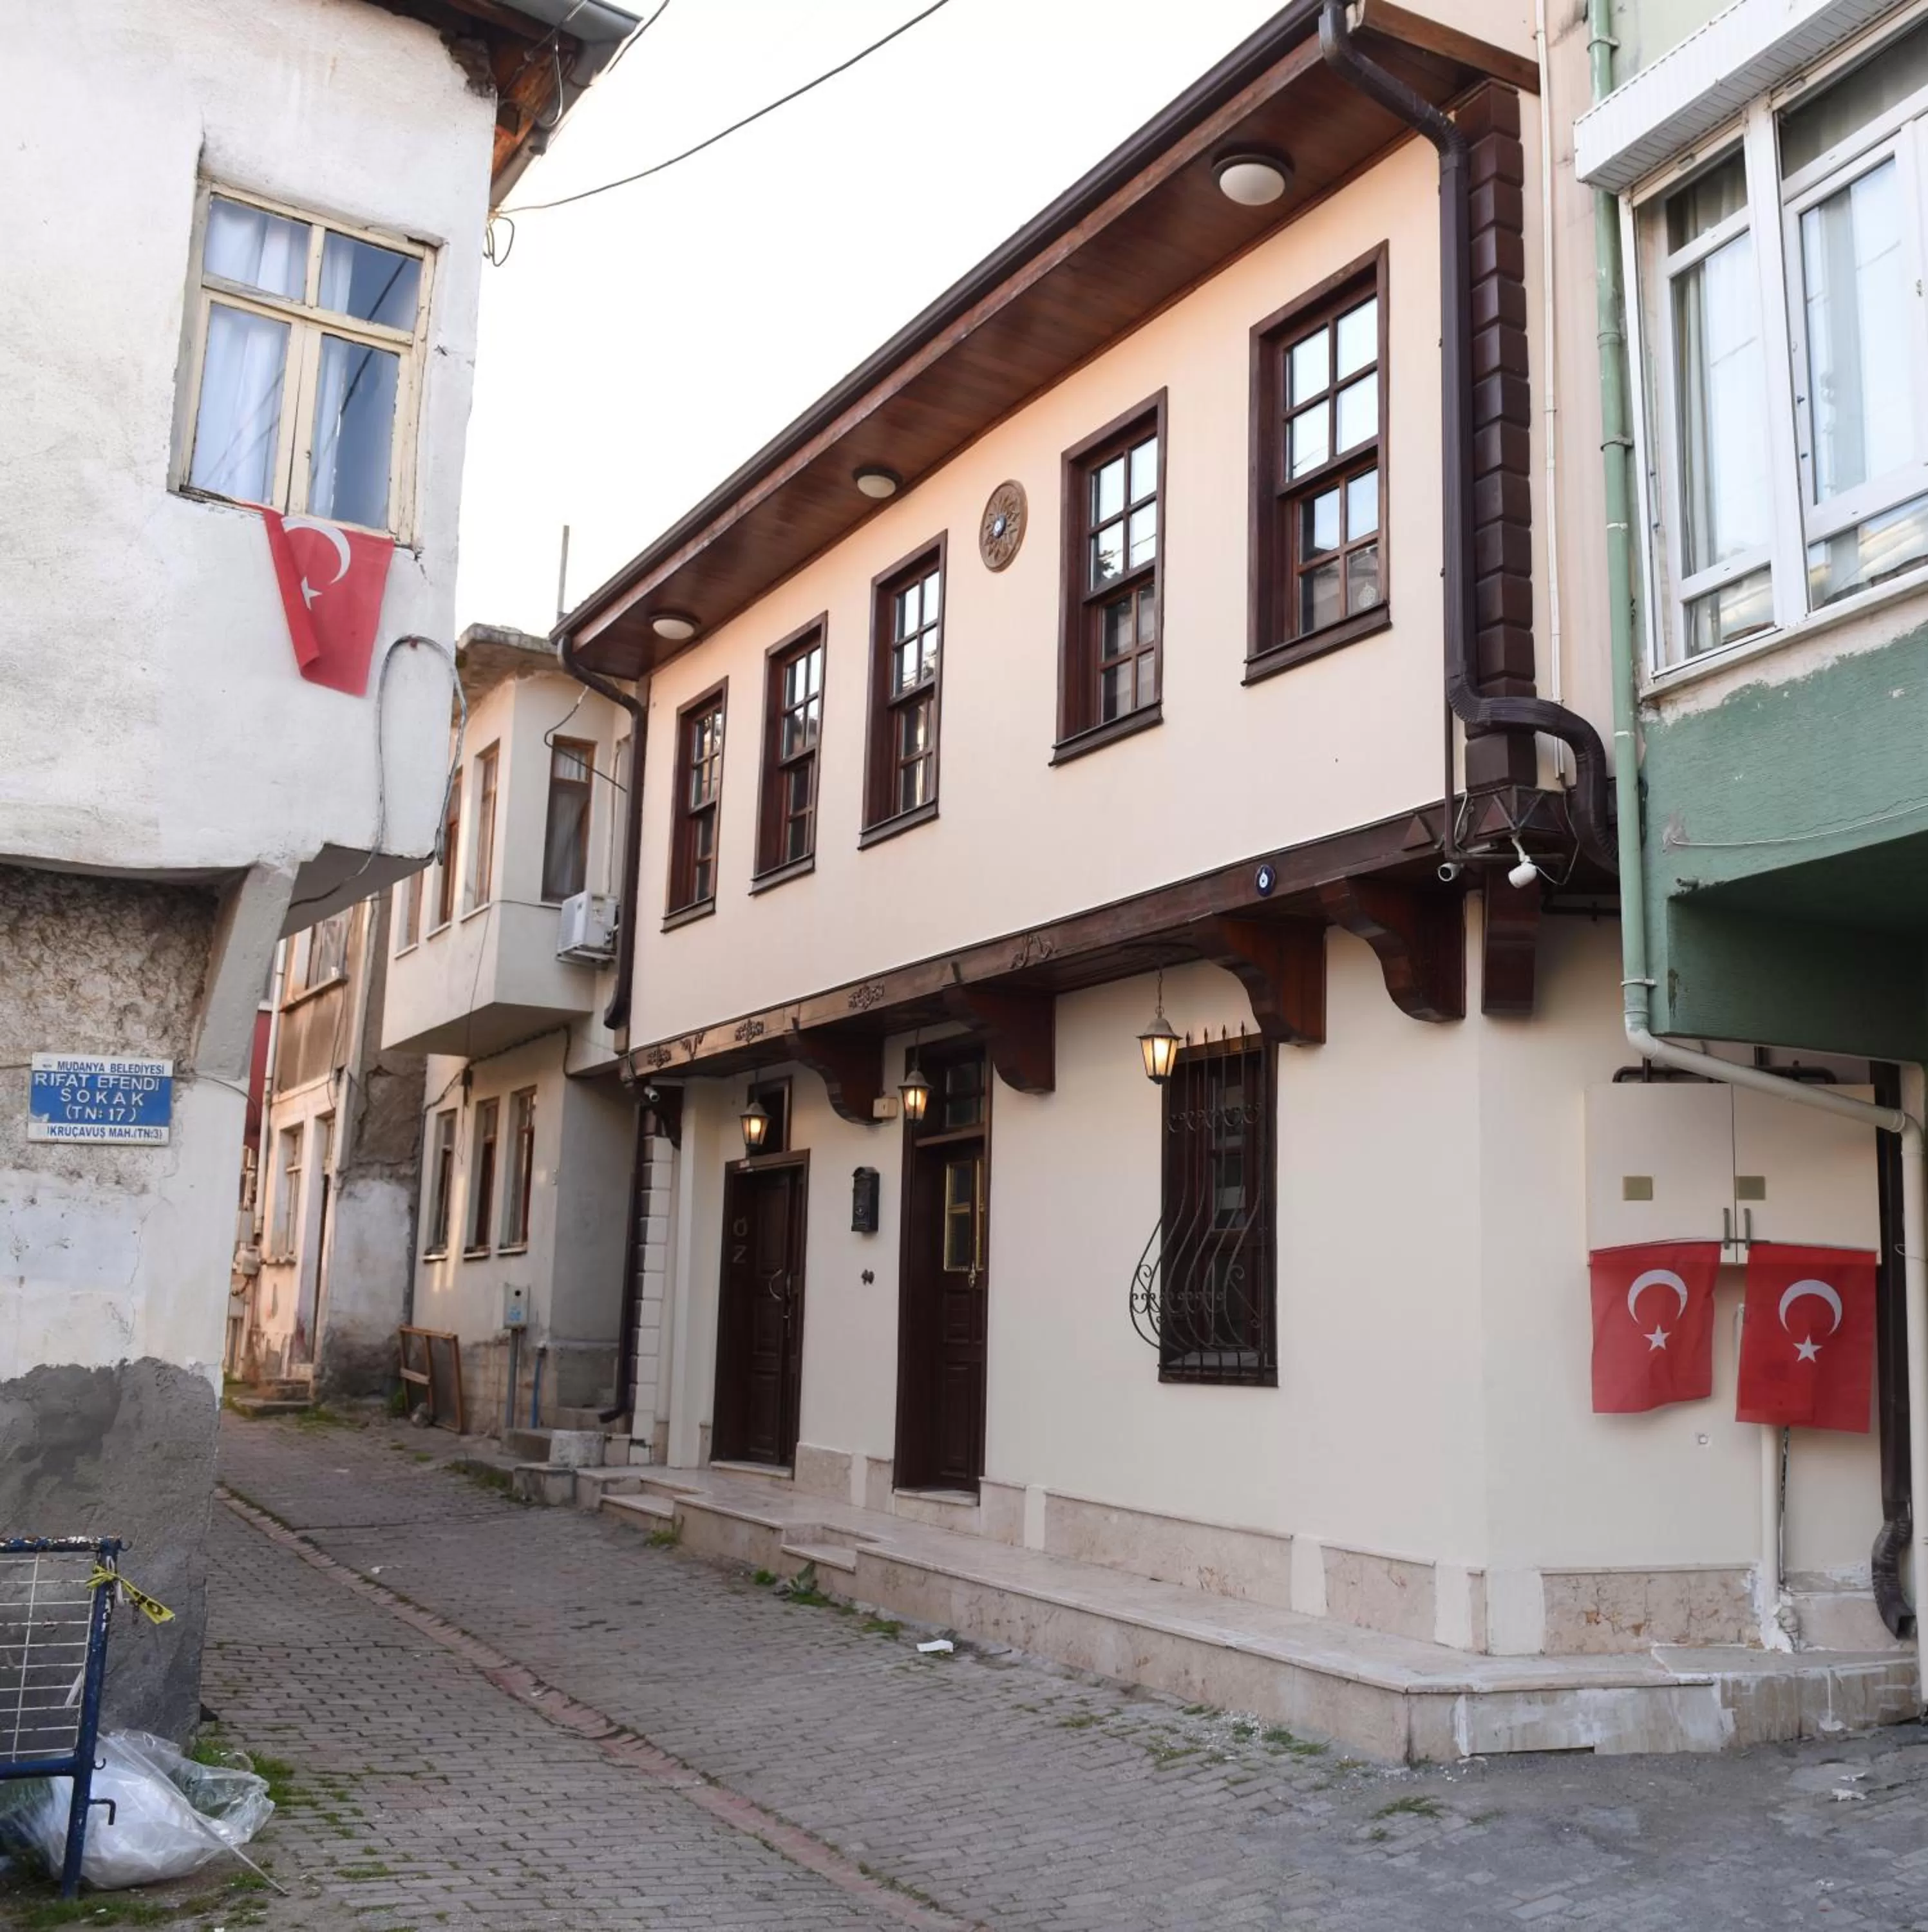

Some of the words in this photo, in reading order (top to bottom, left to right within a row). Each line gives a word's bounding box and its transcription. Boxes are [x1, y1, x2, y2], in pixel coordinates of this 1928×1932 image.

[57, 1061, 105, 1072] MUDANYA
[110, 1062, 164, 1074] BELEDİYESİ
[60, 1088, 145, 1106] SOKAK
